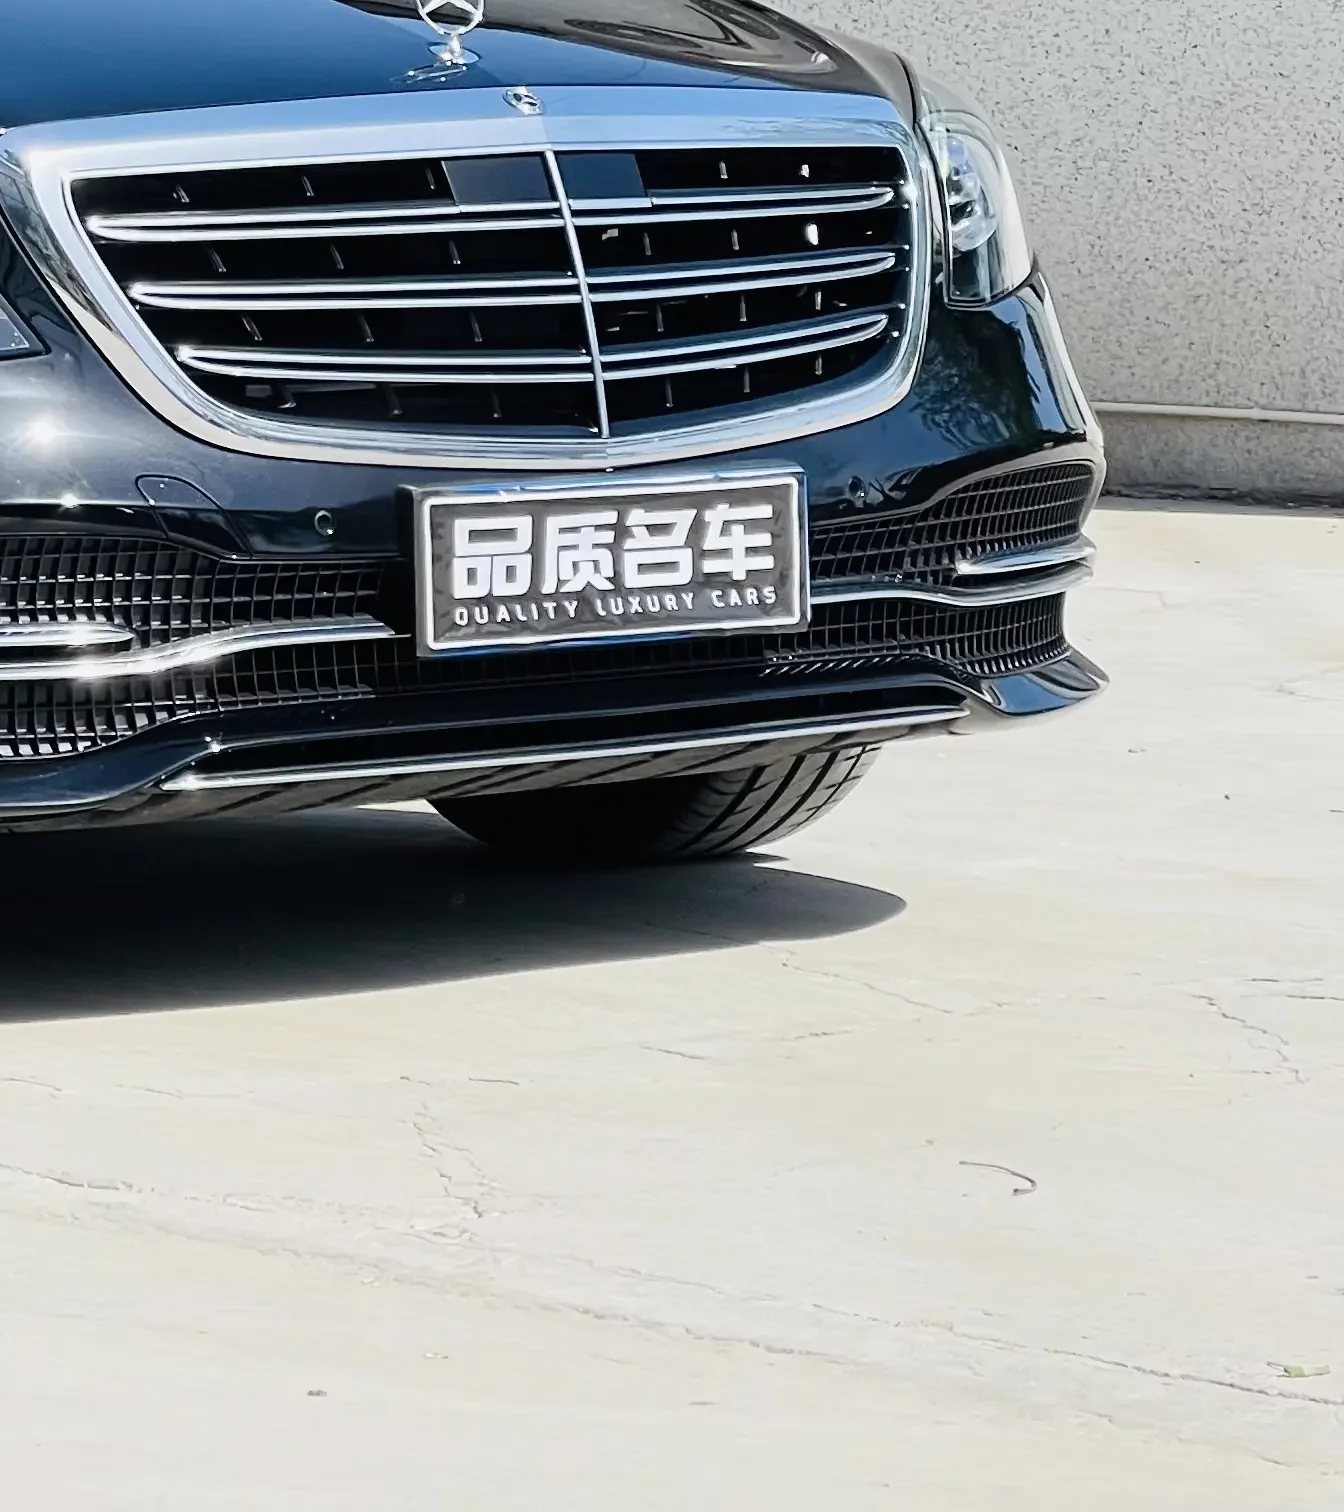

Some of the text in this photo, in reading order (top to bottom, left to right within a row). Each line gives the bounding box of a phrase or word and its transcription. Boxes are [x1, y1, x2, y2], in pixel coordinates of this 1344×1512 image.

[451, 502, 776, 600] 品质名车
[453, 585, 777, 627] QUALITY LUXURY CARS
